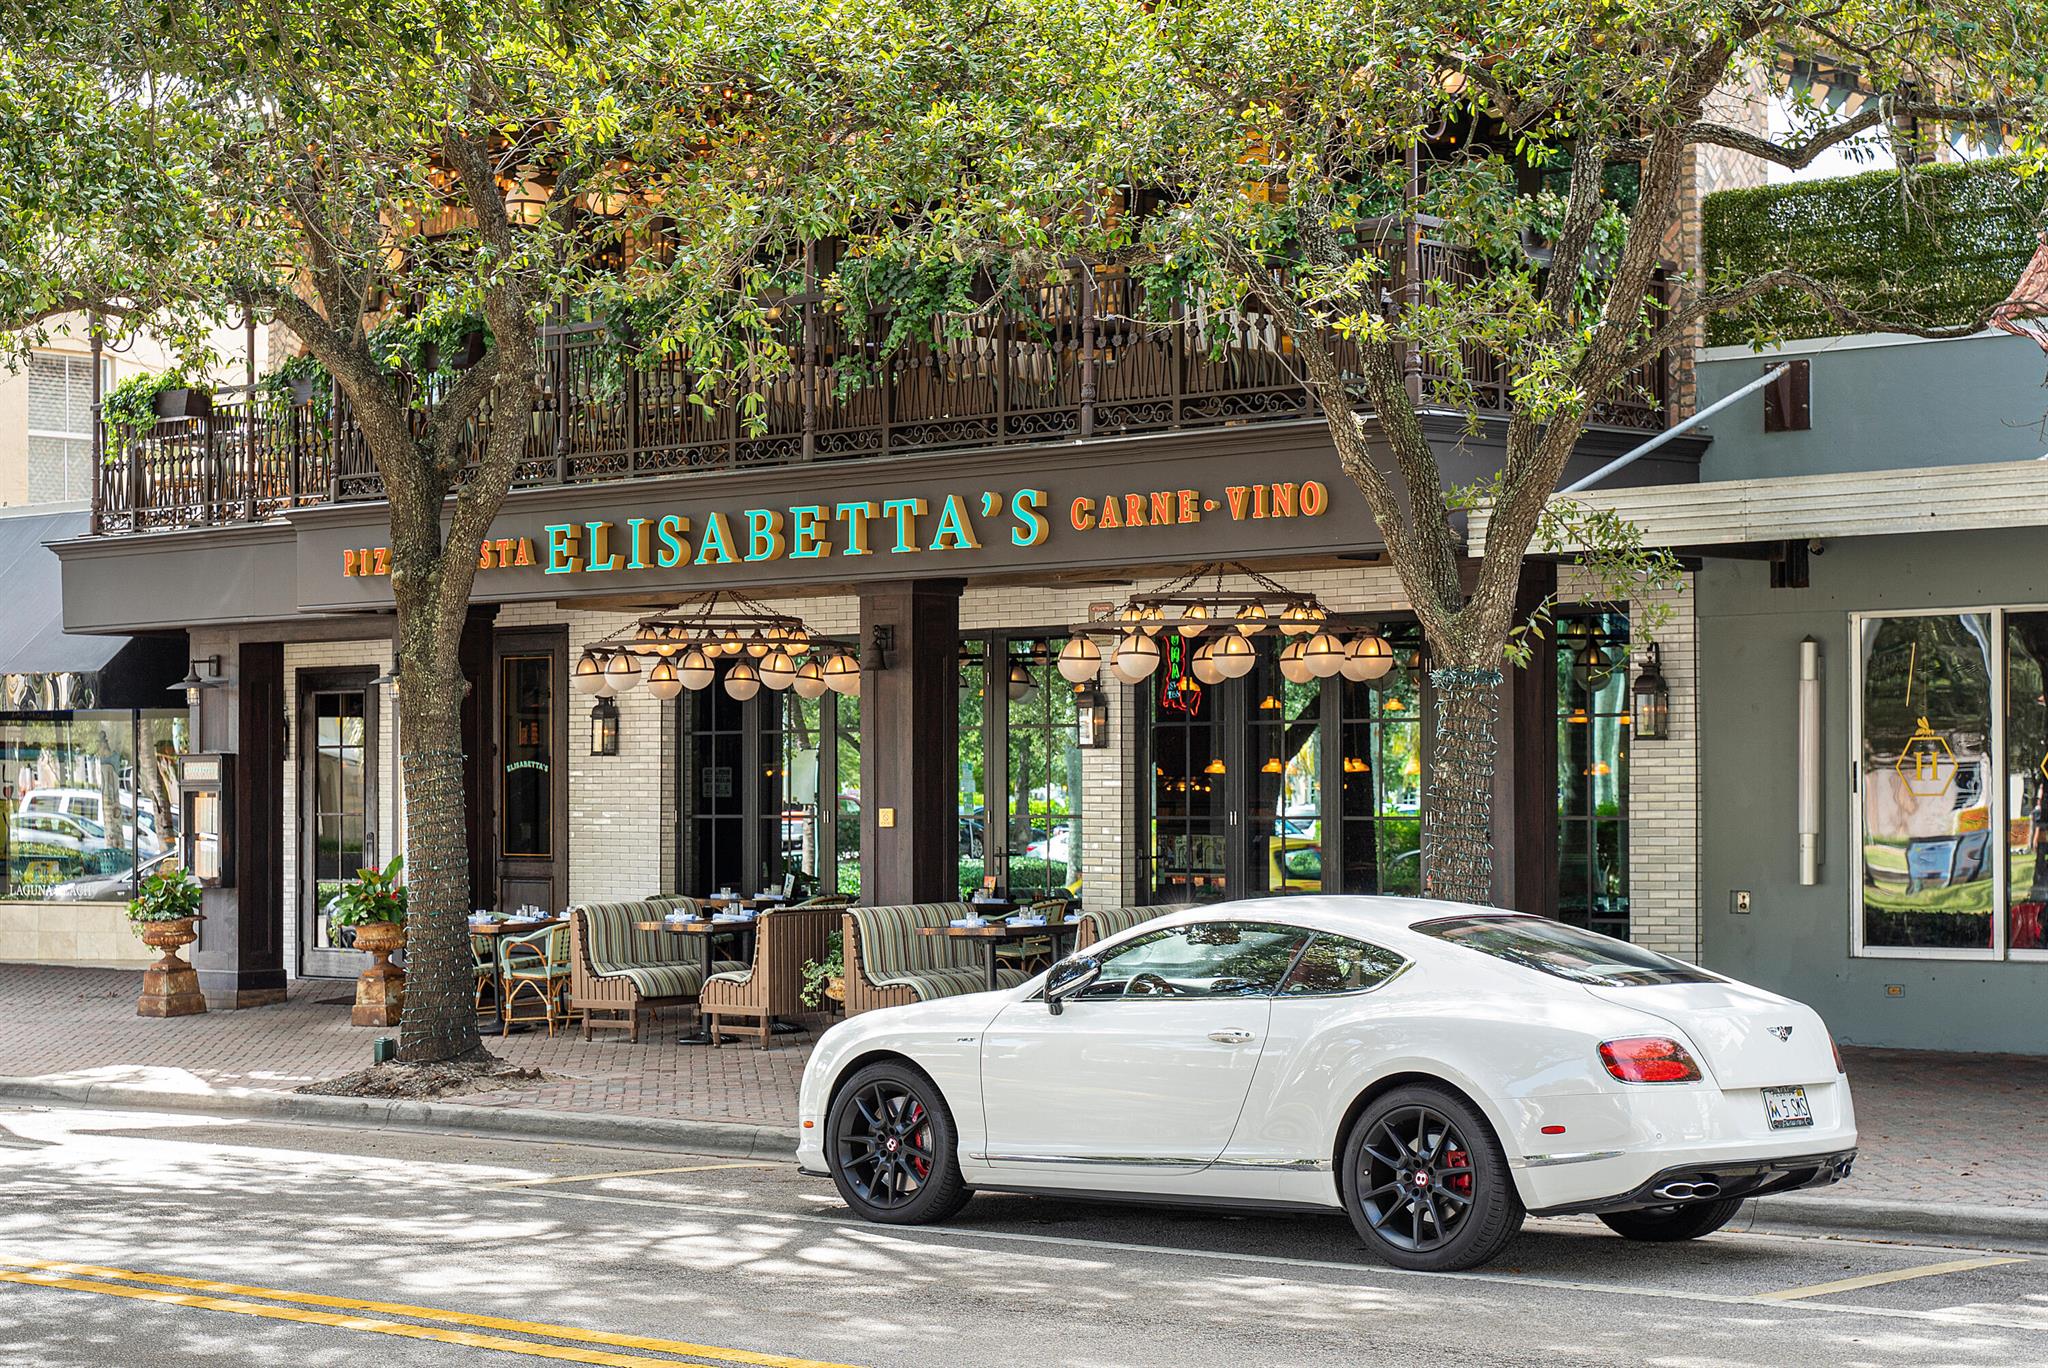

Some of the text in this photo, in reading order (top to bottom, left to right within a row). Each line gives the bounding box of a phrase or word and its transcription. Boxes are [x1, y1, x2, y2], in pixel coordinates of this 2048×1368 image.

[344, 547, 391, 577] PIZ
[545, 488, 1048, 574] ELISABETTA'S
[1225, 480, 1328, 520] VINO
[506, 760, 549, 772] ELISABETTA'S
[9, 884, 92, 897] LAGUNA EACH
